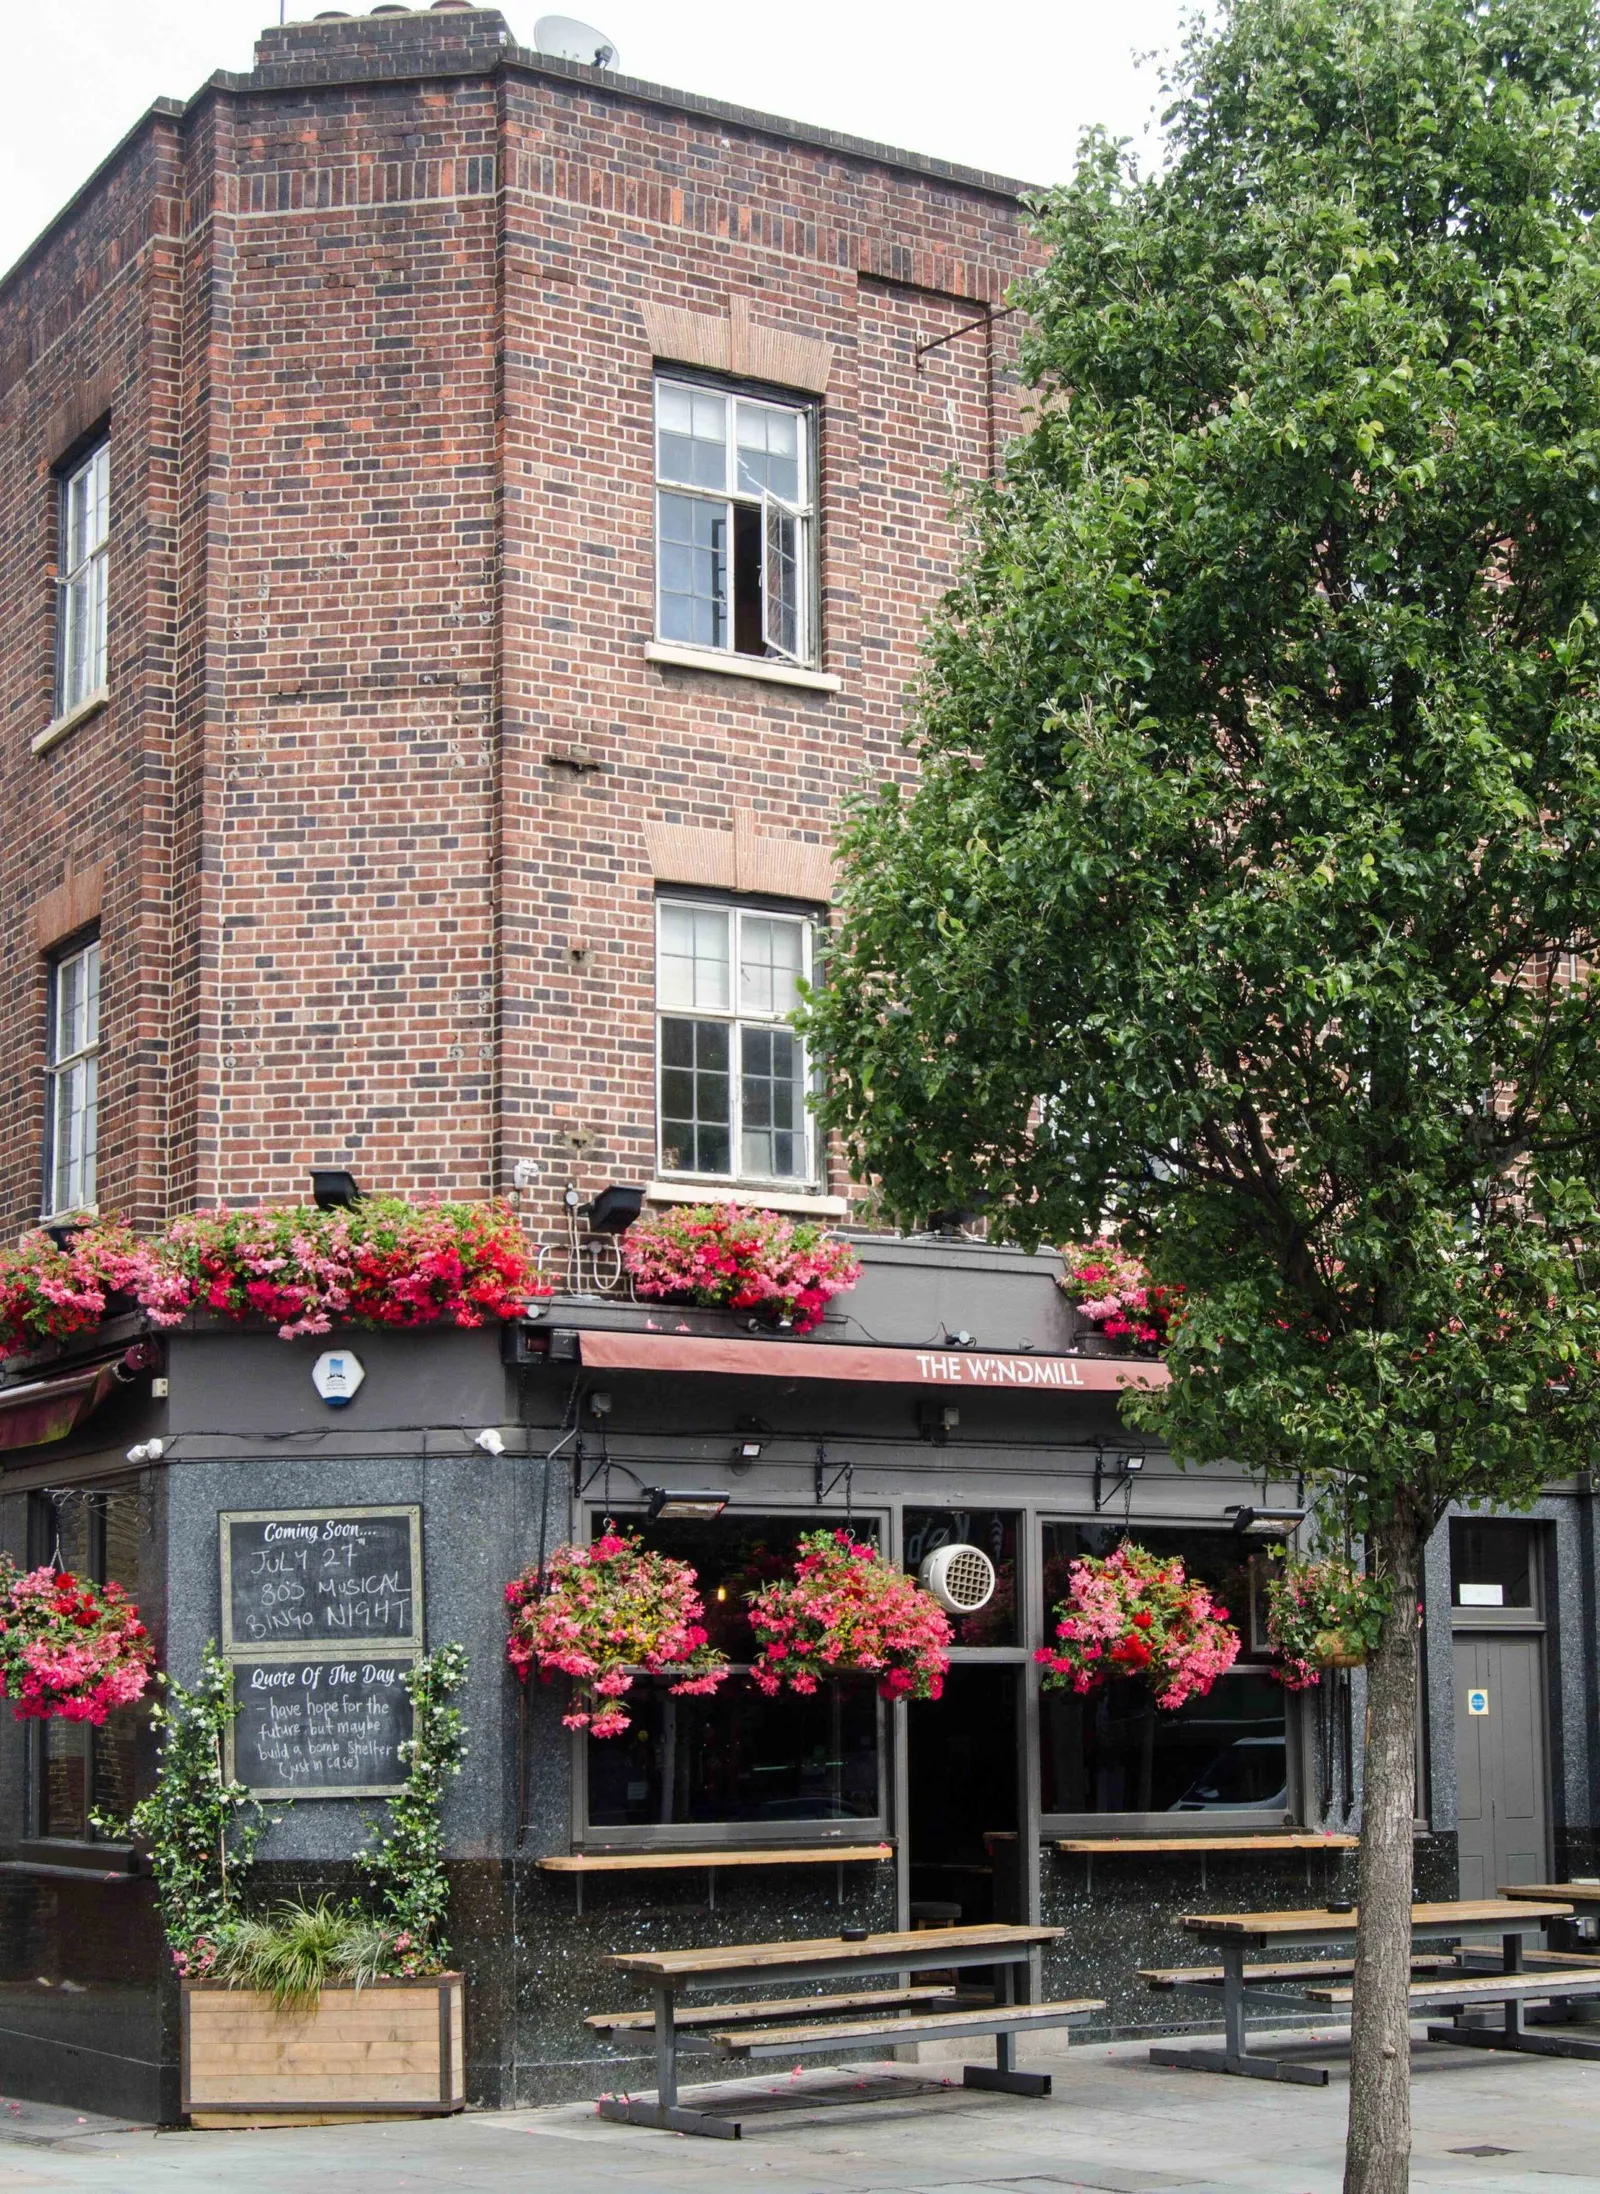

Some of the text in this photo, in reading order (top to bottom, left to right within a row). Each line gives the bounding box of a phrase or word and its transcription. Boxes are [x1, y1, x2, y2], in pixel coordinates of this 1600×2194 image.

[916, 1356, 1084, 1385] THE WINDMILL
[264, 1523, 318, 1543] Coming
[327, 1598, 409, 1629] NIGHT
[251, 1665, 395, 1689] Quote Of The Day
[270, 1696, 302, 1720] have
[307, 1692, 339, 1719] hope
[342, 1695, 362, 1713] for
[366, 1695, 389, 1714] the
[308, 1718, 334, 1736] but
[337, 1716, 381, 1739] maybe
[258, 1743, 290, 1761] build
[293, 1746, 301, 1754] a
[307, 1737, 340, 1755] bomb
[279, 1756, 359, 1779] (just in case)
